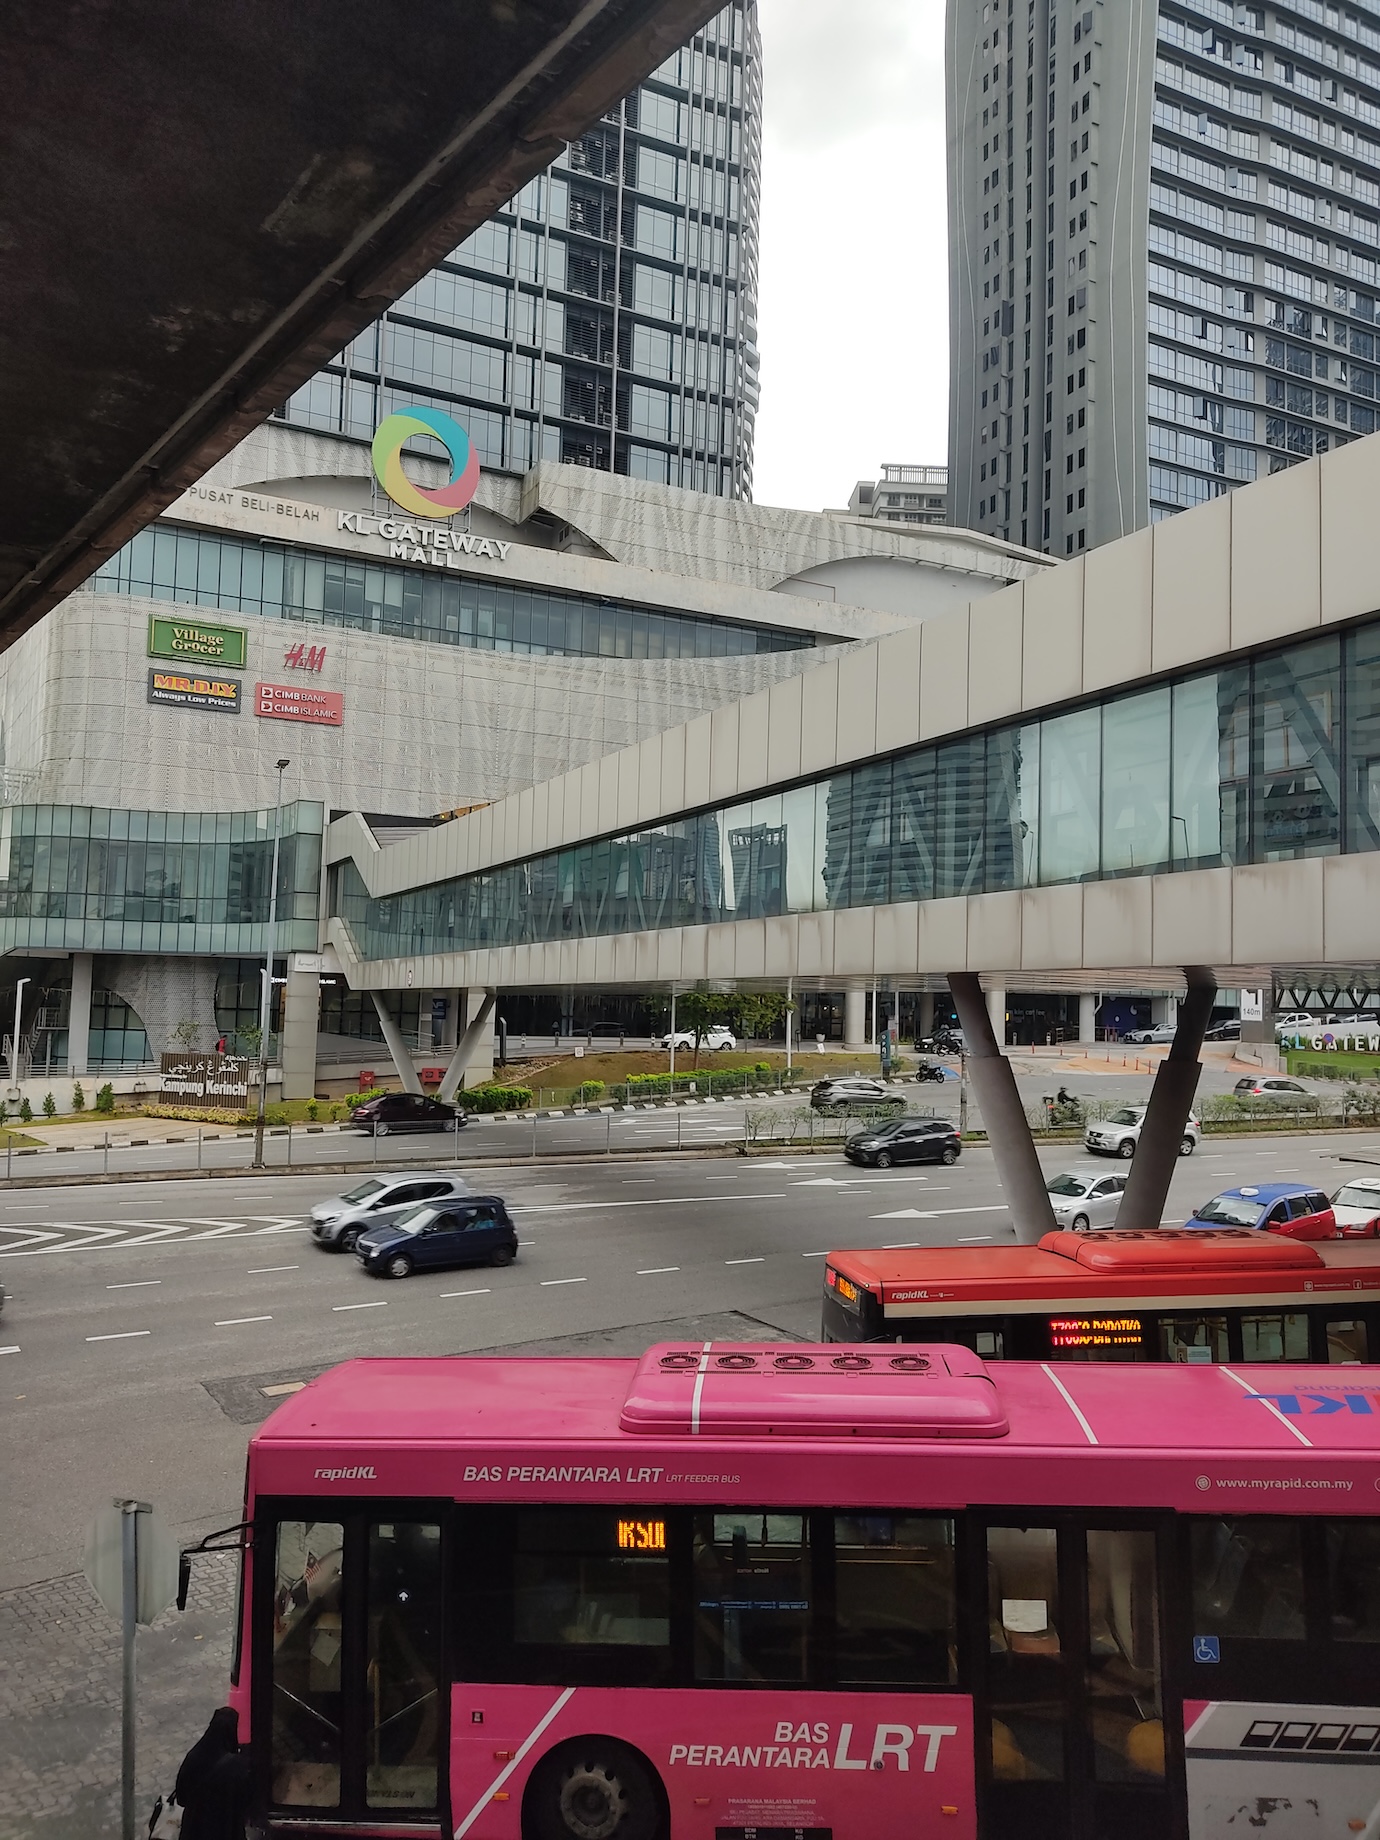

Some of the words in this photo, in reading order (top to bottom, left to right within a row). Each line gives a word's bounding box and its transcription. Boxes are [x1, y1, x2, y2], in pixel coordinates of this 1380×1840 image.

[189, 487, 234, 504] PUSAT
[241, 496, 320, 521] BELI-BELAH
[337, 510, 371, 535] KL
[378, 520, 513, 560] GATEWAY
[389, 542, 459, 568] MALL
[172, 627, 225, 645] Village
[171, 639, 225, 656] Grocer
[283, 643, 327, 673] H&M
[152, 690, 186, 703] Always
[187, 694, 207, 704] Low
[208, 697, 237, 708] Prices
[274, 690, 300, 700] CIMB
[301, 692, 327, 704] BANK
[273, 704, 300, 714] CIMB
[301, 706, 337, 719] ISLAMIC
[1243, 1008, 1261, 1016] 140m
[1281, 1033, 1306, 1050] KL
[160, 1078, 204, 1097] Kampung
[206, 1080, 247, 1096] Kerinchi
[891, 1290, 929, 1300] rapidKL
[1243, 1394, 1380, 1414] KL
[314, 1466, 378, 1481] rapidKL
[463, 1466, 502, 1482] BAS
[506, 1466, 621, 1483] PERANTARA
[626, 1467, 664, 1483] LRT
[666, 1474, 684, 1483] LRT
[684, 1474, 719, 1483] FEEDER
[721, 1475, 741, 1484] BUS
[1216, 1478, 1353, 1491] www.myrapid.com.my
[774, 1721, 830, 1743] BAS
[669, 1745, 831, 1769] PERANTARA
[833, 1723, 958, 1773] LRT
